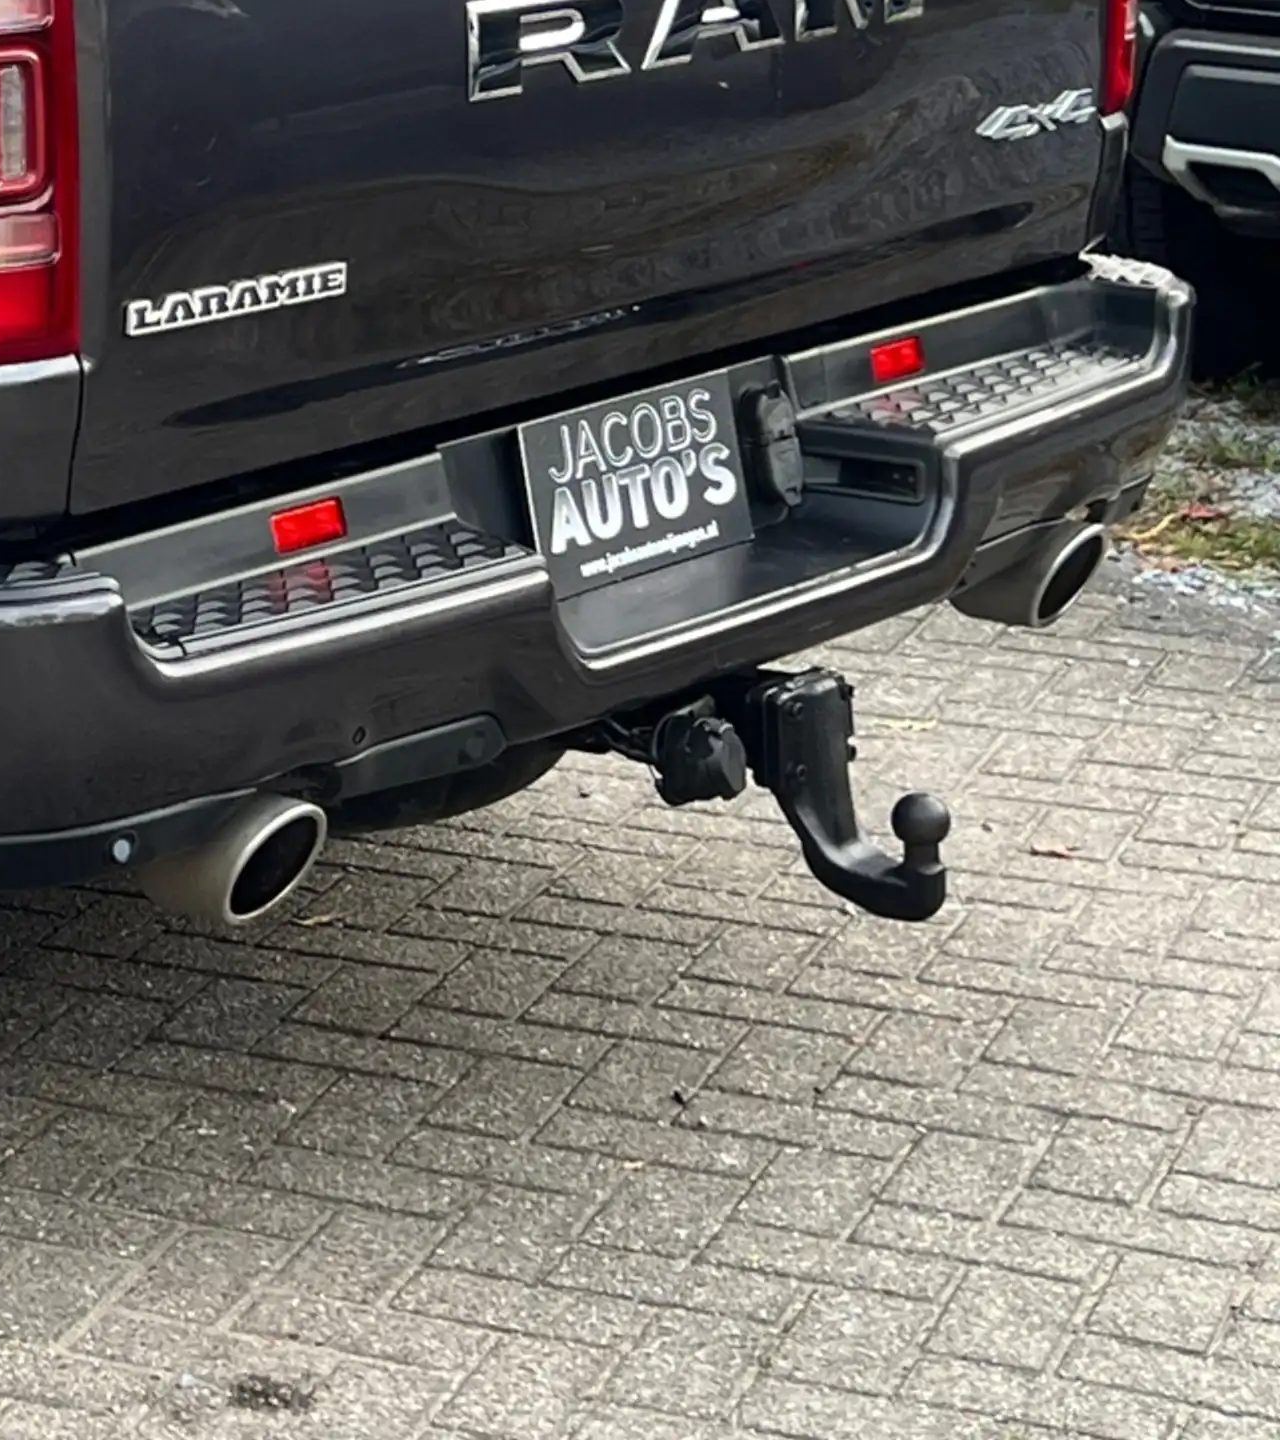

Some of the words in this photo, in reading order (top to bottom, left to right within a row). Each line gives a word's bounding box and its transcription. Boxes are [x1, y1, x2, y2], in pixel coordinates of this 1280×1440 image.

[126, 261, 348, 337] LARAMIE
[547, 388, 718, 484] JACOBS
[550, 442, 738, 555] AUTO'S
